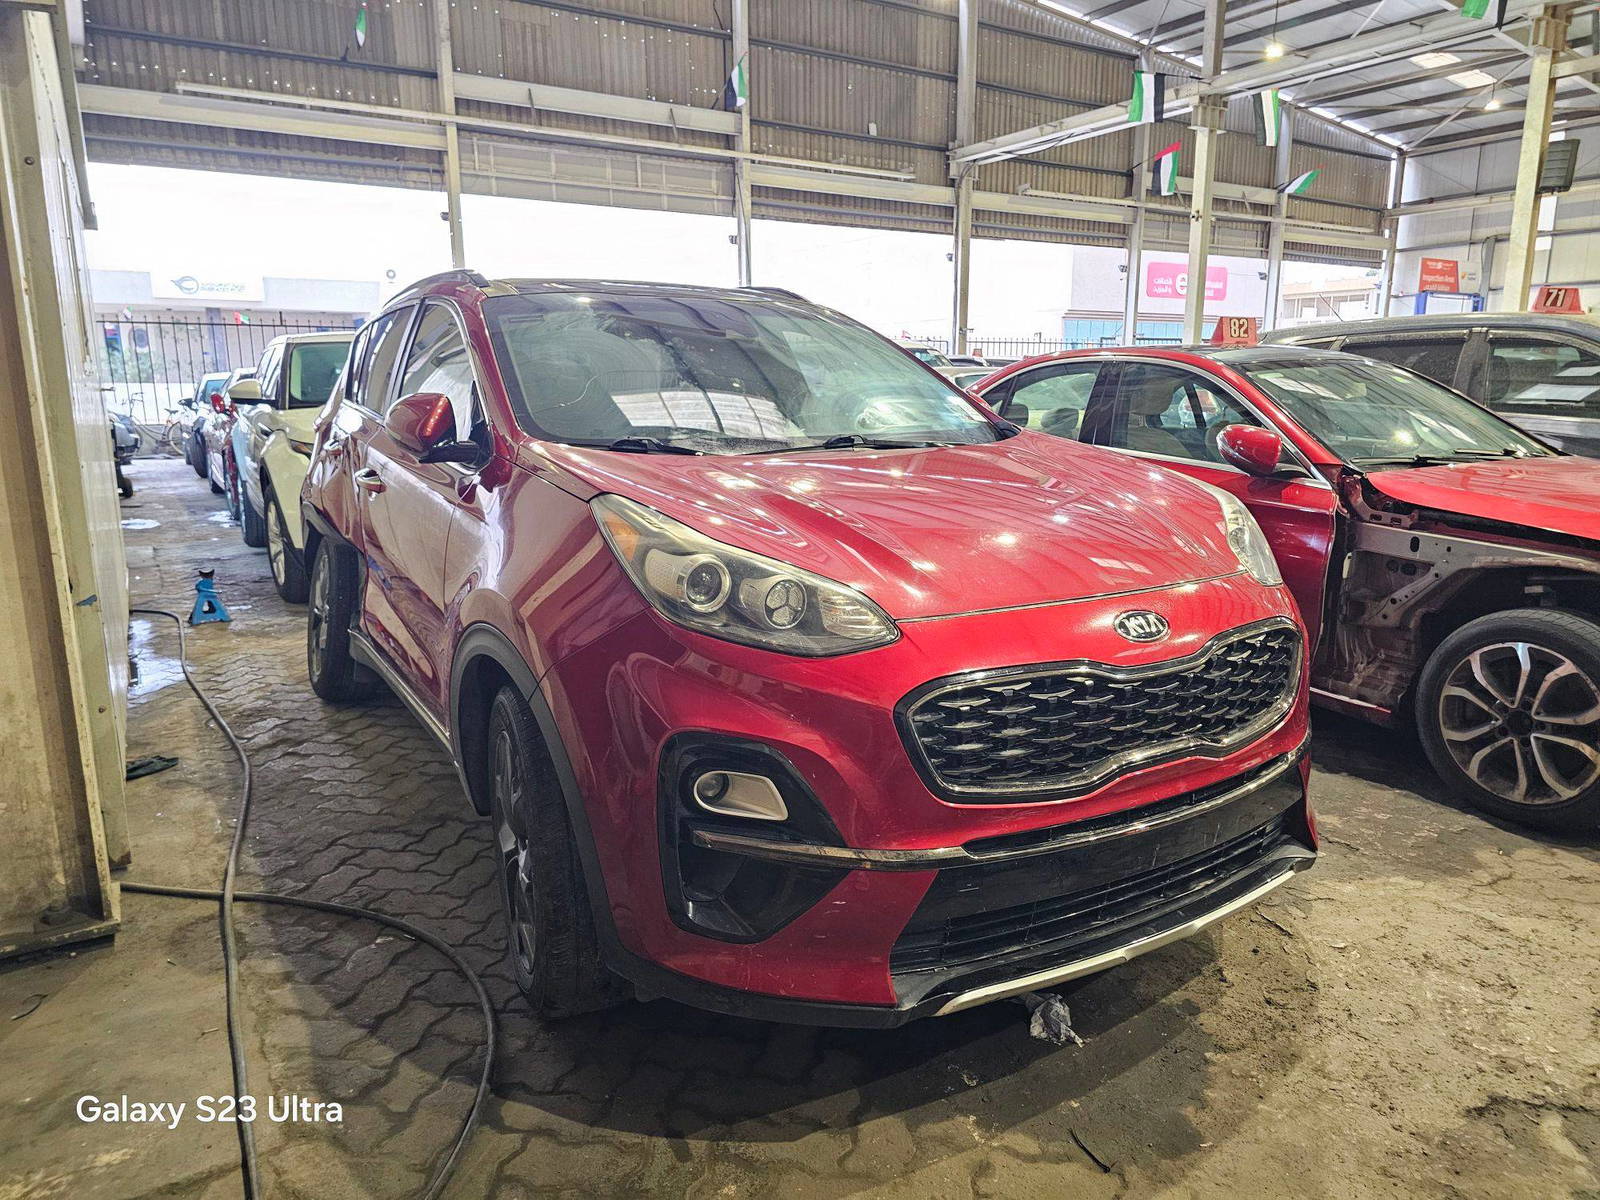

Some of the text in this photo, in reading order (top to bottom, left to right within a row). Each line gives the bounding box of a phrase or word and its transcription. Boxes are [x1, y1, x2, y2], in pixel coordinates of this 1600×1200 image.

[1545, 289, 1565, 307] 71
[1230, 318, 1248, 338] 82
[1121, 614, 1164, 637] KIA
